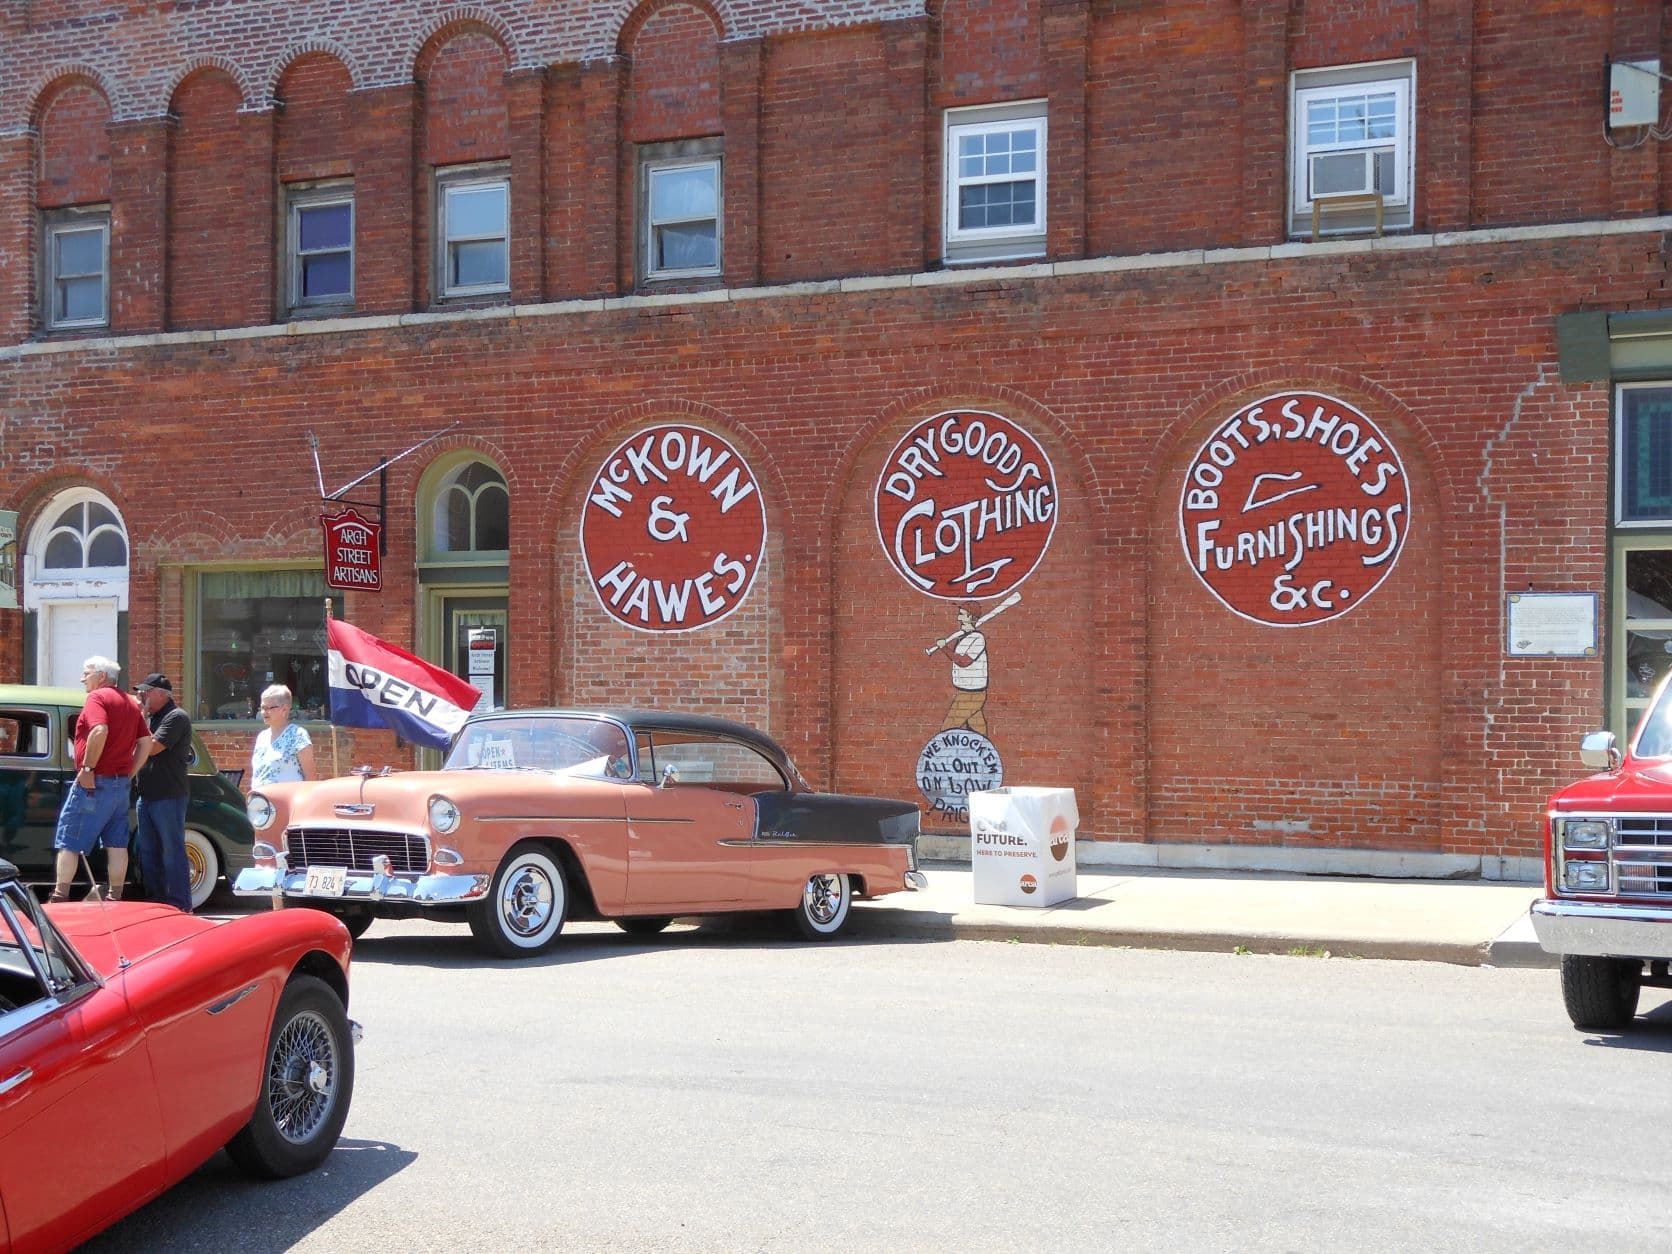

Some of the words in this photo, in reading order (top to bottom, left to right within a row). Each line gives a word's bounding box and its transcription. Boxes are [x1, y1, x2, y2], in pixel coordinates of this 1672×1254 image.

[885, 428, 944, 502] DRY
[940, 418, 1041, 492] GOODS
[1281, 399, 1398, 496] SHOES
[648, 495, 690, 542] &
[340, 528, 367, 546] ARCH
[895, 485, 1054, 593] CLOTHING
[1197, 503, 1402, 572] FURNISHINGS
[337, 547, 373, 565] STREET
[333, 566, 378, 584] ARTISANS
[598, 552, 752, 622] HAWES.
[345, 663, 438, 717] OPEN
[922, 741, 942, 759] WE
[942, 734, 987, 757] KNOCK
[924, 760, 951, 773] ALL
[952, 758, 979, 774] OUT
[922, 776, 942, 792] ON
[948, 776, 992, 796] LOW
[925, 797, 970, 824] PRIC
[976, 833, 1028, 846] FUTURE.
